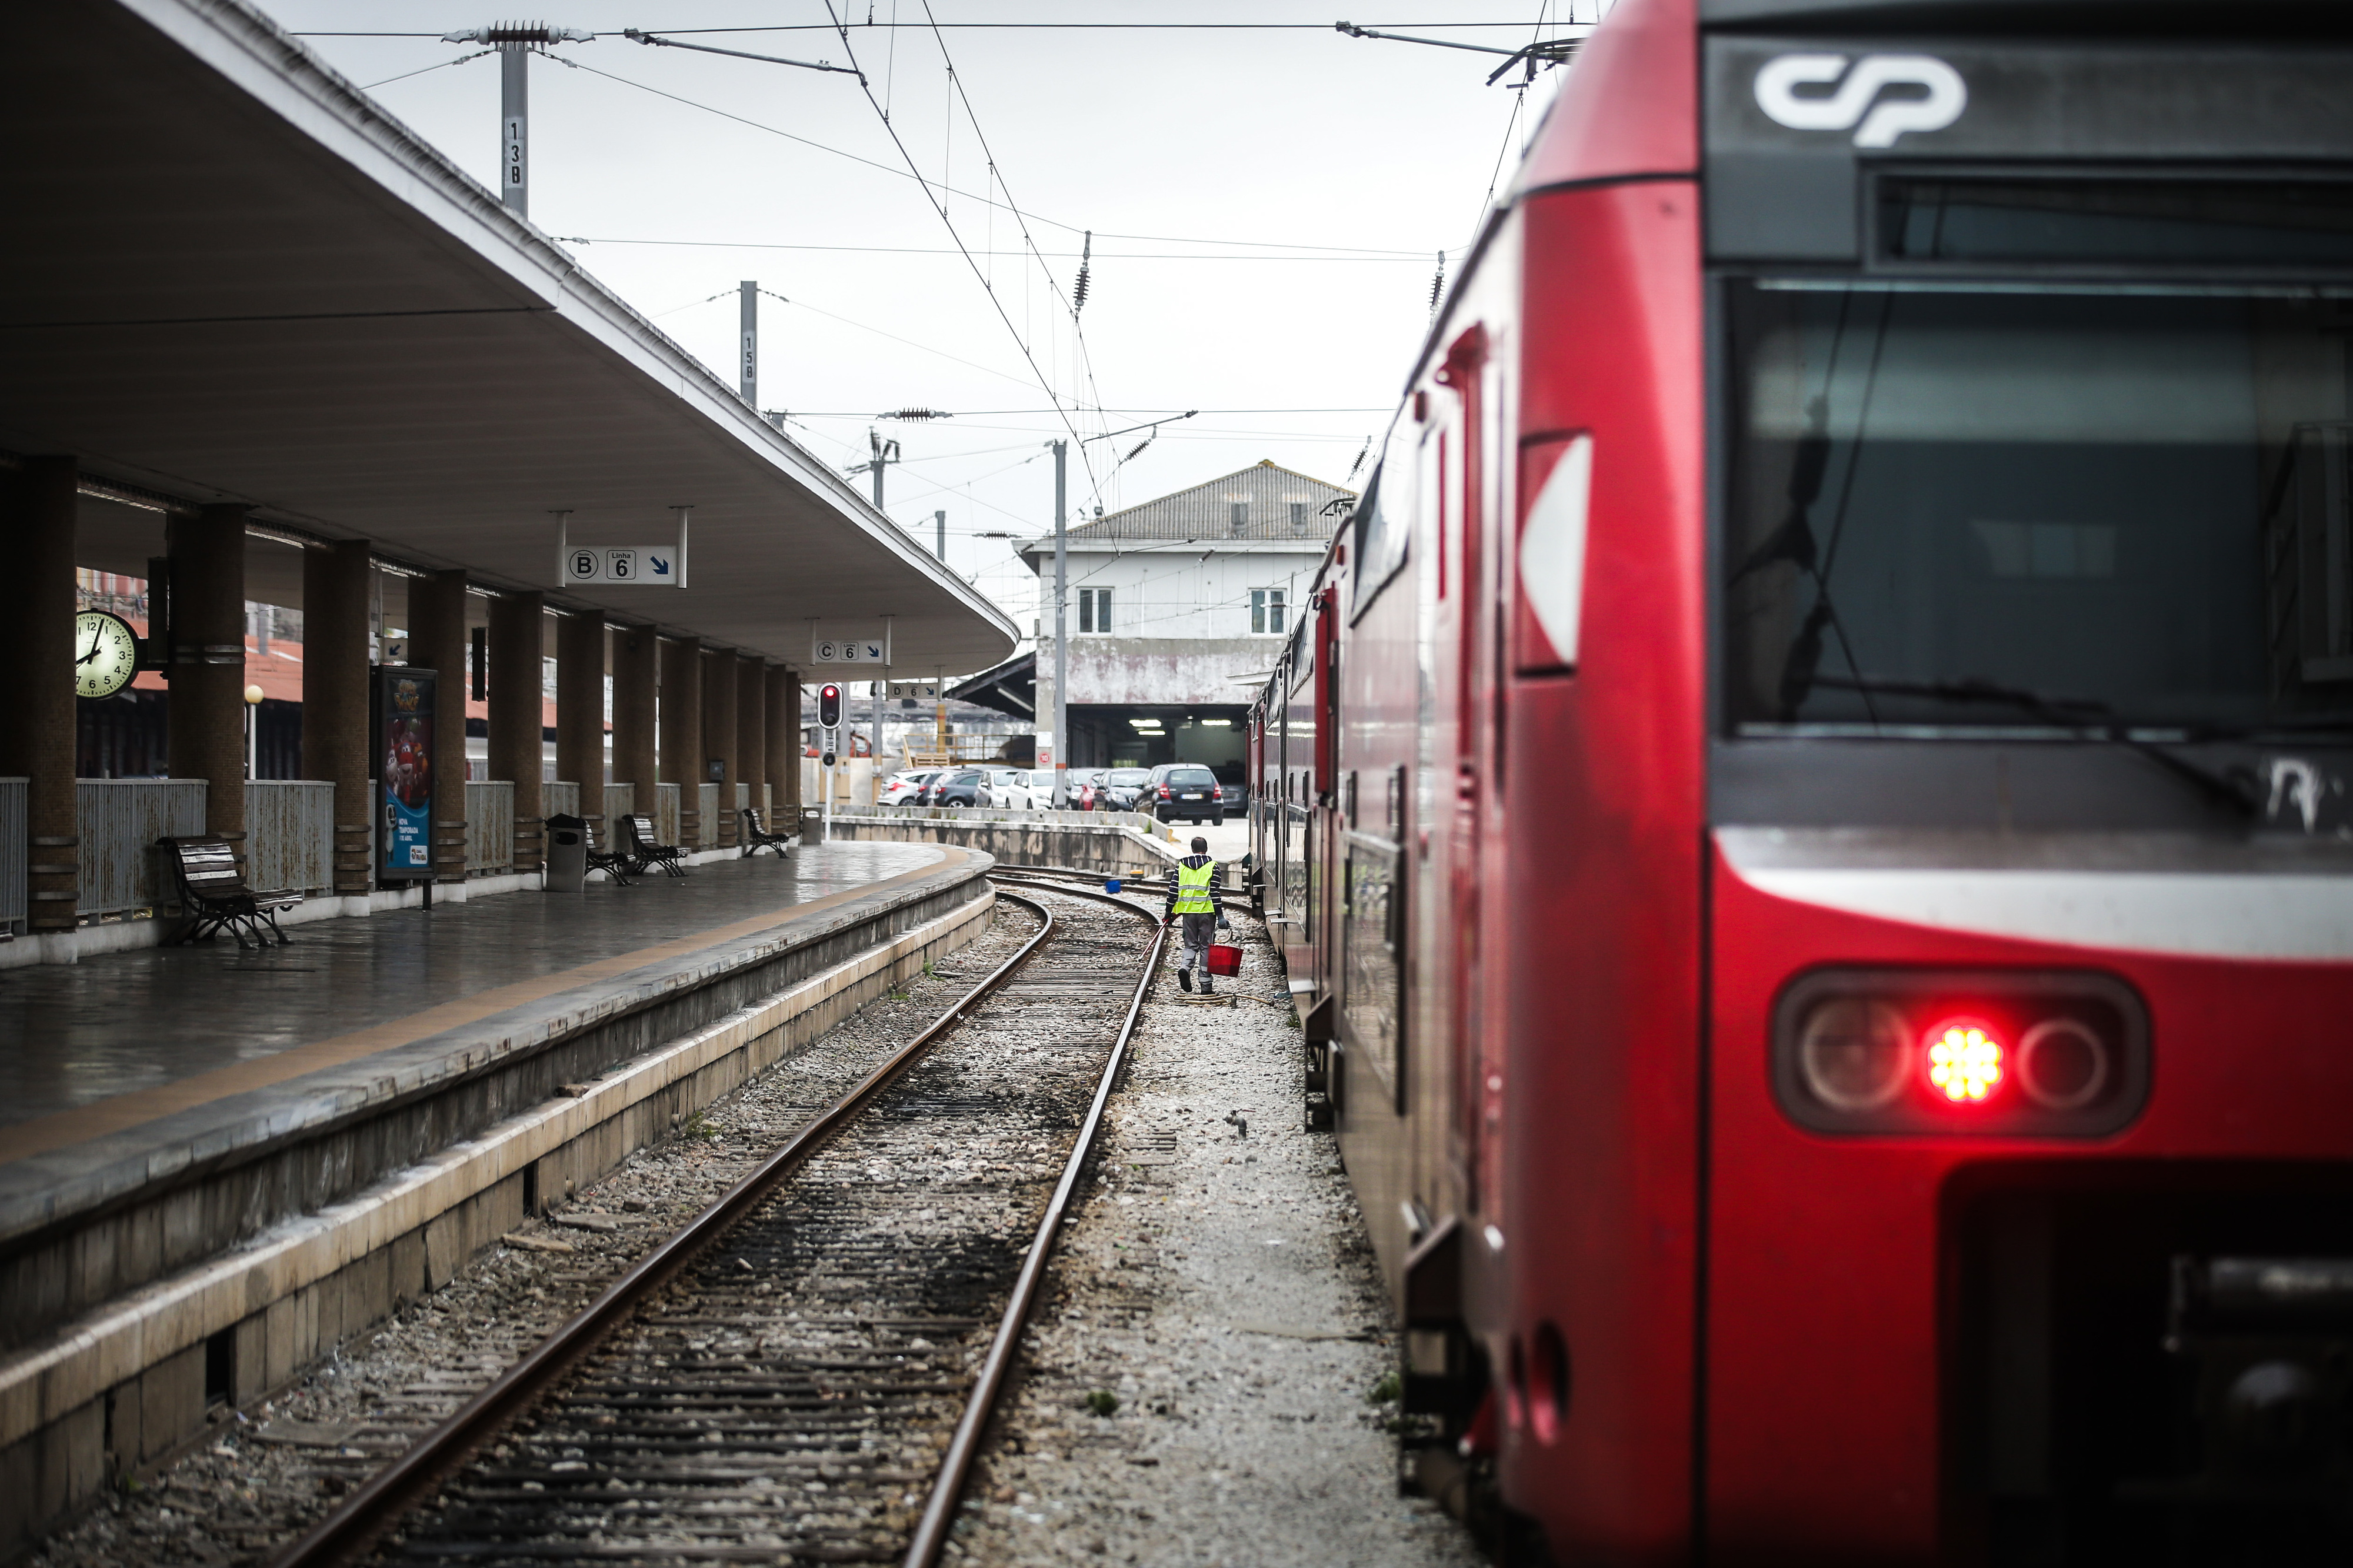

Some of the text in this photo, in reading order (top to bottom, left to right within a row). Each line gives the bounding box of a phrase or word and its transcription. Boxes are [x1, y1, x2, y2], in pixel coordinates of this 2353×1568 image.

[577, 557, 592, 573] B
[616, 559, 628, 577] 6
[88, 622, 96, 630] 12
[105, 626, 108, 634] 1
[114, 636, 121, 644] 2
[119, 651, 126, 659] 3
[822, 646, 831, 657] C
[846, 648, 854, 658] 6
[114, 666, 121, 674] 4
[104, 676, 111, 684] 5
[89, 680, 96, 689] 6
